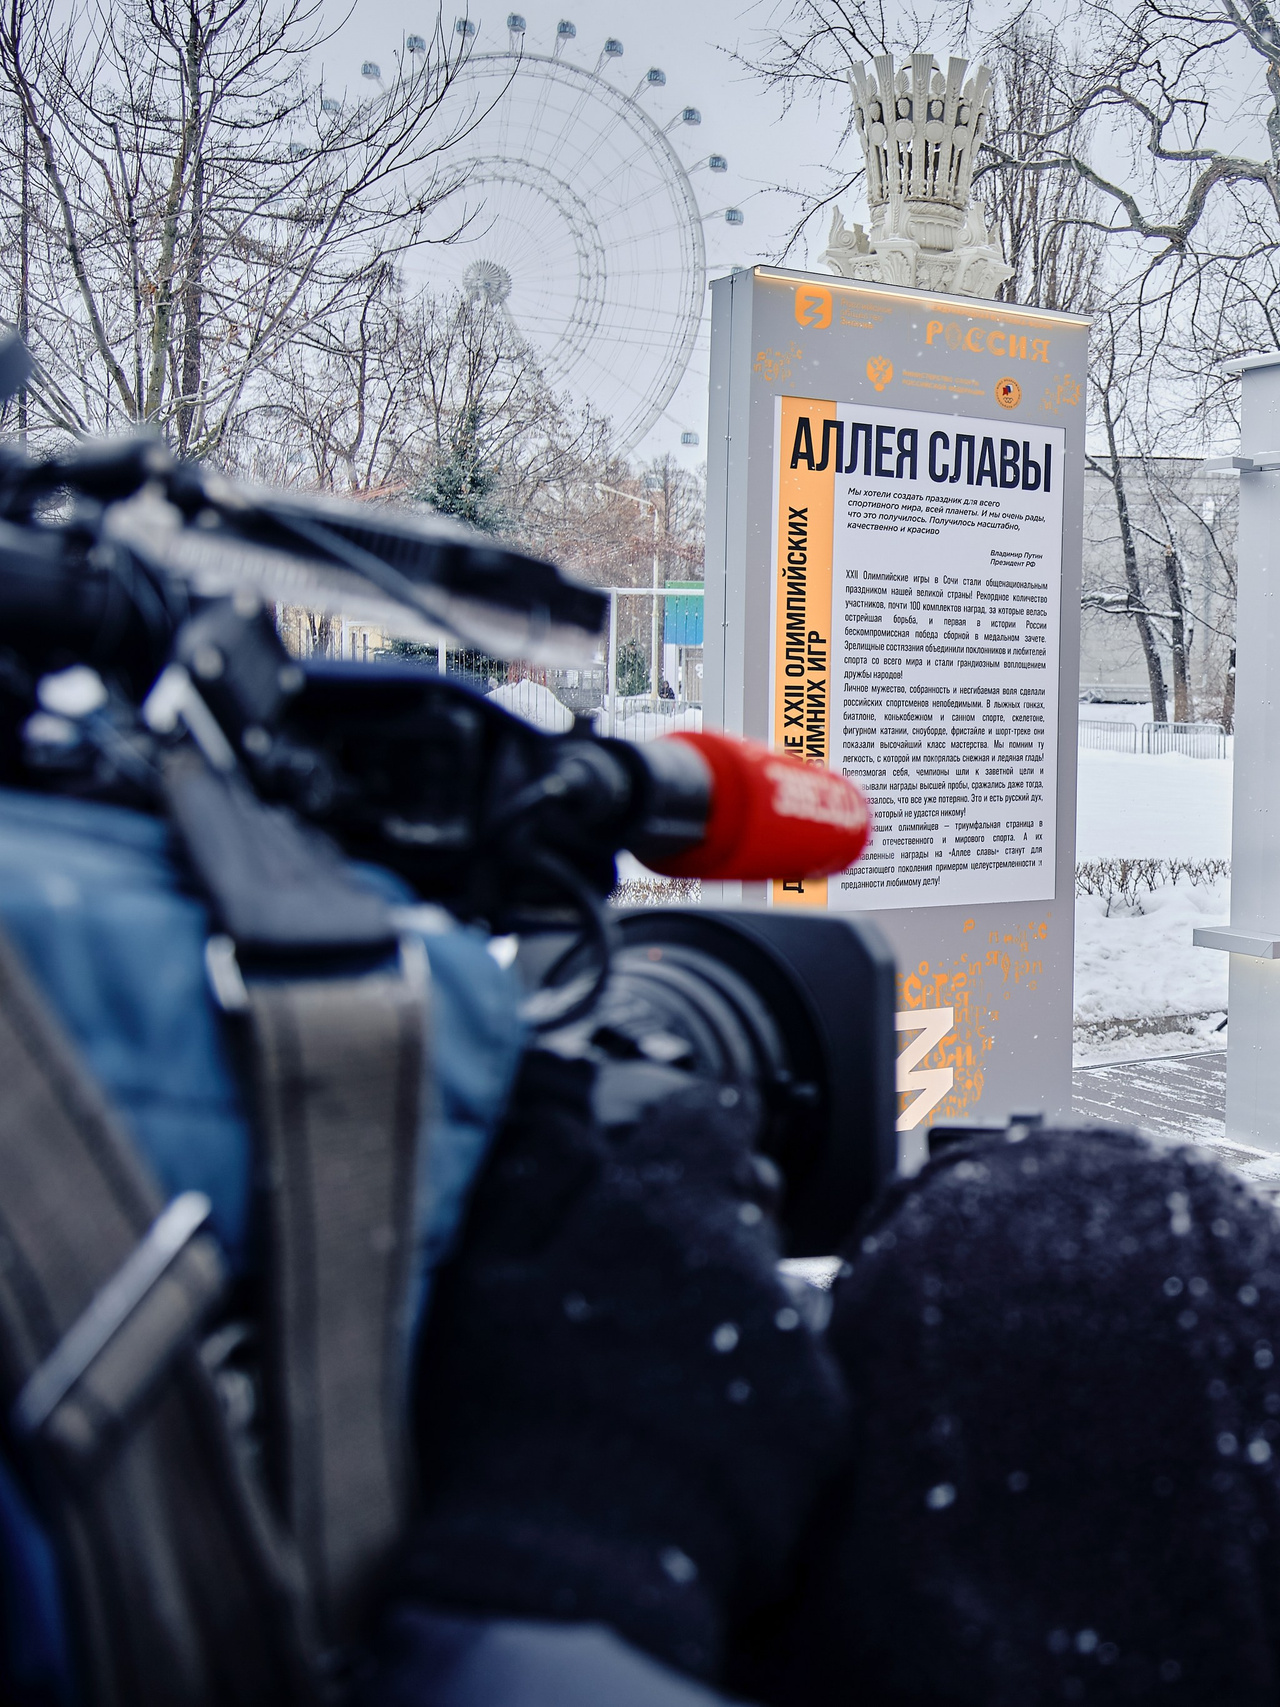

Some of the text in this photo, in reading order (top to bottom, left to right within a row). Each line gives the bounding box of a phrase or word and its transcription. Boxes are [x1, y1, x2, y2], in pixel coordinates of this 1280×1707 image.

[924, 320, 1051, 364] РОССИЯ
[790, 416, 1052, 493] АЛЛЕЯ СЛАВЫ
[847, 488, 862, 496] Мы
[862, 490, 892, 498] хотели
[892, 493, 924, 501] создать
[924, 496, 963, 504] праздник
[847, 500, 900, 511] спортивного
[900, 504, 924, 513] мира,
[924, 505, 944, 514] всей
[944, 508, 980, 516] планеты.
[1024, 515, 1046, 523] рады,
[846, 522, 899, 532] качественно
[906, 527, 940, 535] красиво
[862, 512, 878, 520] это
[878, 514, 928, 523] получилось.
[928, 516, 976, 527] Получилось
[976, 522, 1020, 531] масштабно,
[990, 550, 1044, 560] Владимир Путин
[990, 558, 1025, 567] Президент
[845, 570, 859, 579] XXII
[862, 570, 909, 582] Олимпийские
[913, 576, 930, 584] игры
[942, 575, 959, 585] Сочи
[962, 578, 982, 586] стали
[985, 578, 1048, 590] общенациональным
[782, 506, 809, 679] ОЛИМПИЙСКИХ
[845, 586, 1048, 603] праздником нашей великой страны! Рекордное количество
[844, 600, 886, 610] участников,
[888, 602, 908, 610] почти
[909, 601, 921, 610] 100
[922, 604, 962, 612] комплектов
[963, 606, 988, 615] наград,
[997, 608, 1025, 616] которые
[844, 613, 883, 623] острейшая
[893, 614, 918, 625] борьба,
[943, 618, 967, 627] первая
[990, 621, 1016, 630] истории
[1025, 620, 1048, 630] России
[844, 626, 910, 638] бескомпромиссная
[914, 629, 939, 640] победа
[943, 630, 970, 641] сборной
[983, 634, 1020, 642] медальном
[1024, 635, 1047, 643] зачете.
[844, 640, 885, 652] Зрелищные
[885, 644, 924, 652] состязания
[924, 644, 965, 654] объединили
[965, 647, 1006, 655] поклонников
[1012, 647, 1047, 656] любителей
[843, 657, 868, 666] спорта
[905, 659, 923, 667] мира
[956, 660, 1000, 668] грандиозным
[1003, 661, 1046, 670] воплощением
[843, 669, 903, 680] дружбы народов!
[843, 683, 869, 692] Личное
[871, 686, 907, 694] мужество,
[909, 685, 951, 695] собранность
[959, 686, 1000, 695] несгибаемая
[784, 684, 805, 728] XXII
[806, 630, 827, 769] ЗИМНИХ ИГР
[843, 698, 883, 708] российских
[885, 700, 930, 709] спортсменов
[932, 699, 984, 709] непобедимыми.
[986, 699, 991, 708] В
[842, 711, 877, 721] биатлоне,
[884, 712, 934, 721] конькобежном
[982, 715, 1006, 723] спорте,
[1011, 715, 1045, 723] скелетоне,
[842, 725, 877, 736] фигурном
[880, 728, 909, 736] катании,
[912, 726, 948, 737] сноуборде,
[950, 726, 986, 737] фристайле
[995, 728, 1032, 737] шорт-треке
[879, 740, 922, 749] высочайший
[950, 742, 990, 750] мастерства.
[993, 740, 1005, 748] Мы
[1037, 742, 1045, 750] ту
[842, 756, 875, 764] легкость,
[882, 754, 910, 764] которой
[922, 755, 961, 764] покорялась
[997, 755, 1024, 763] ледяная
[1024, 753, 1044, 762] гладь!
